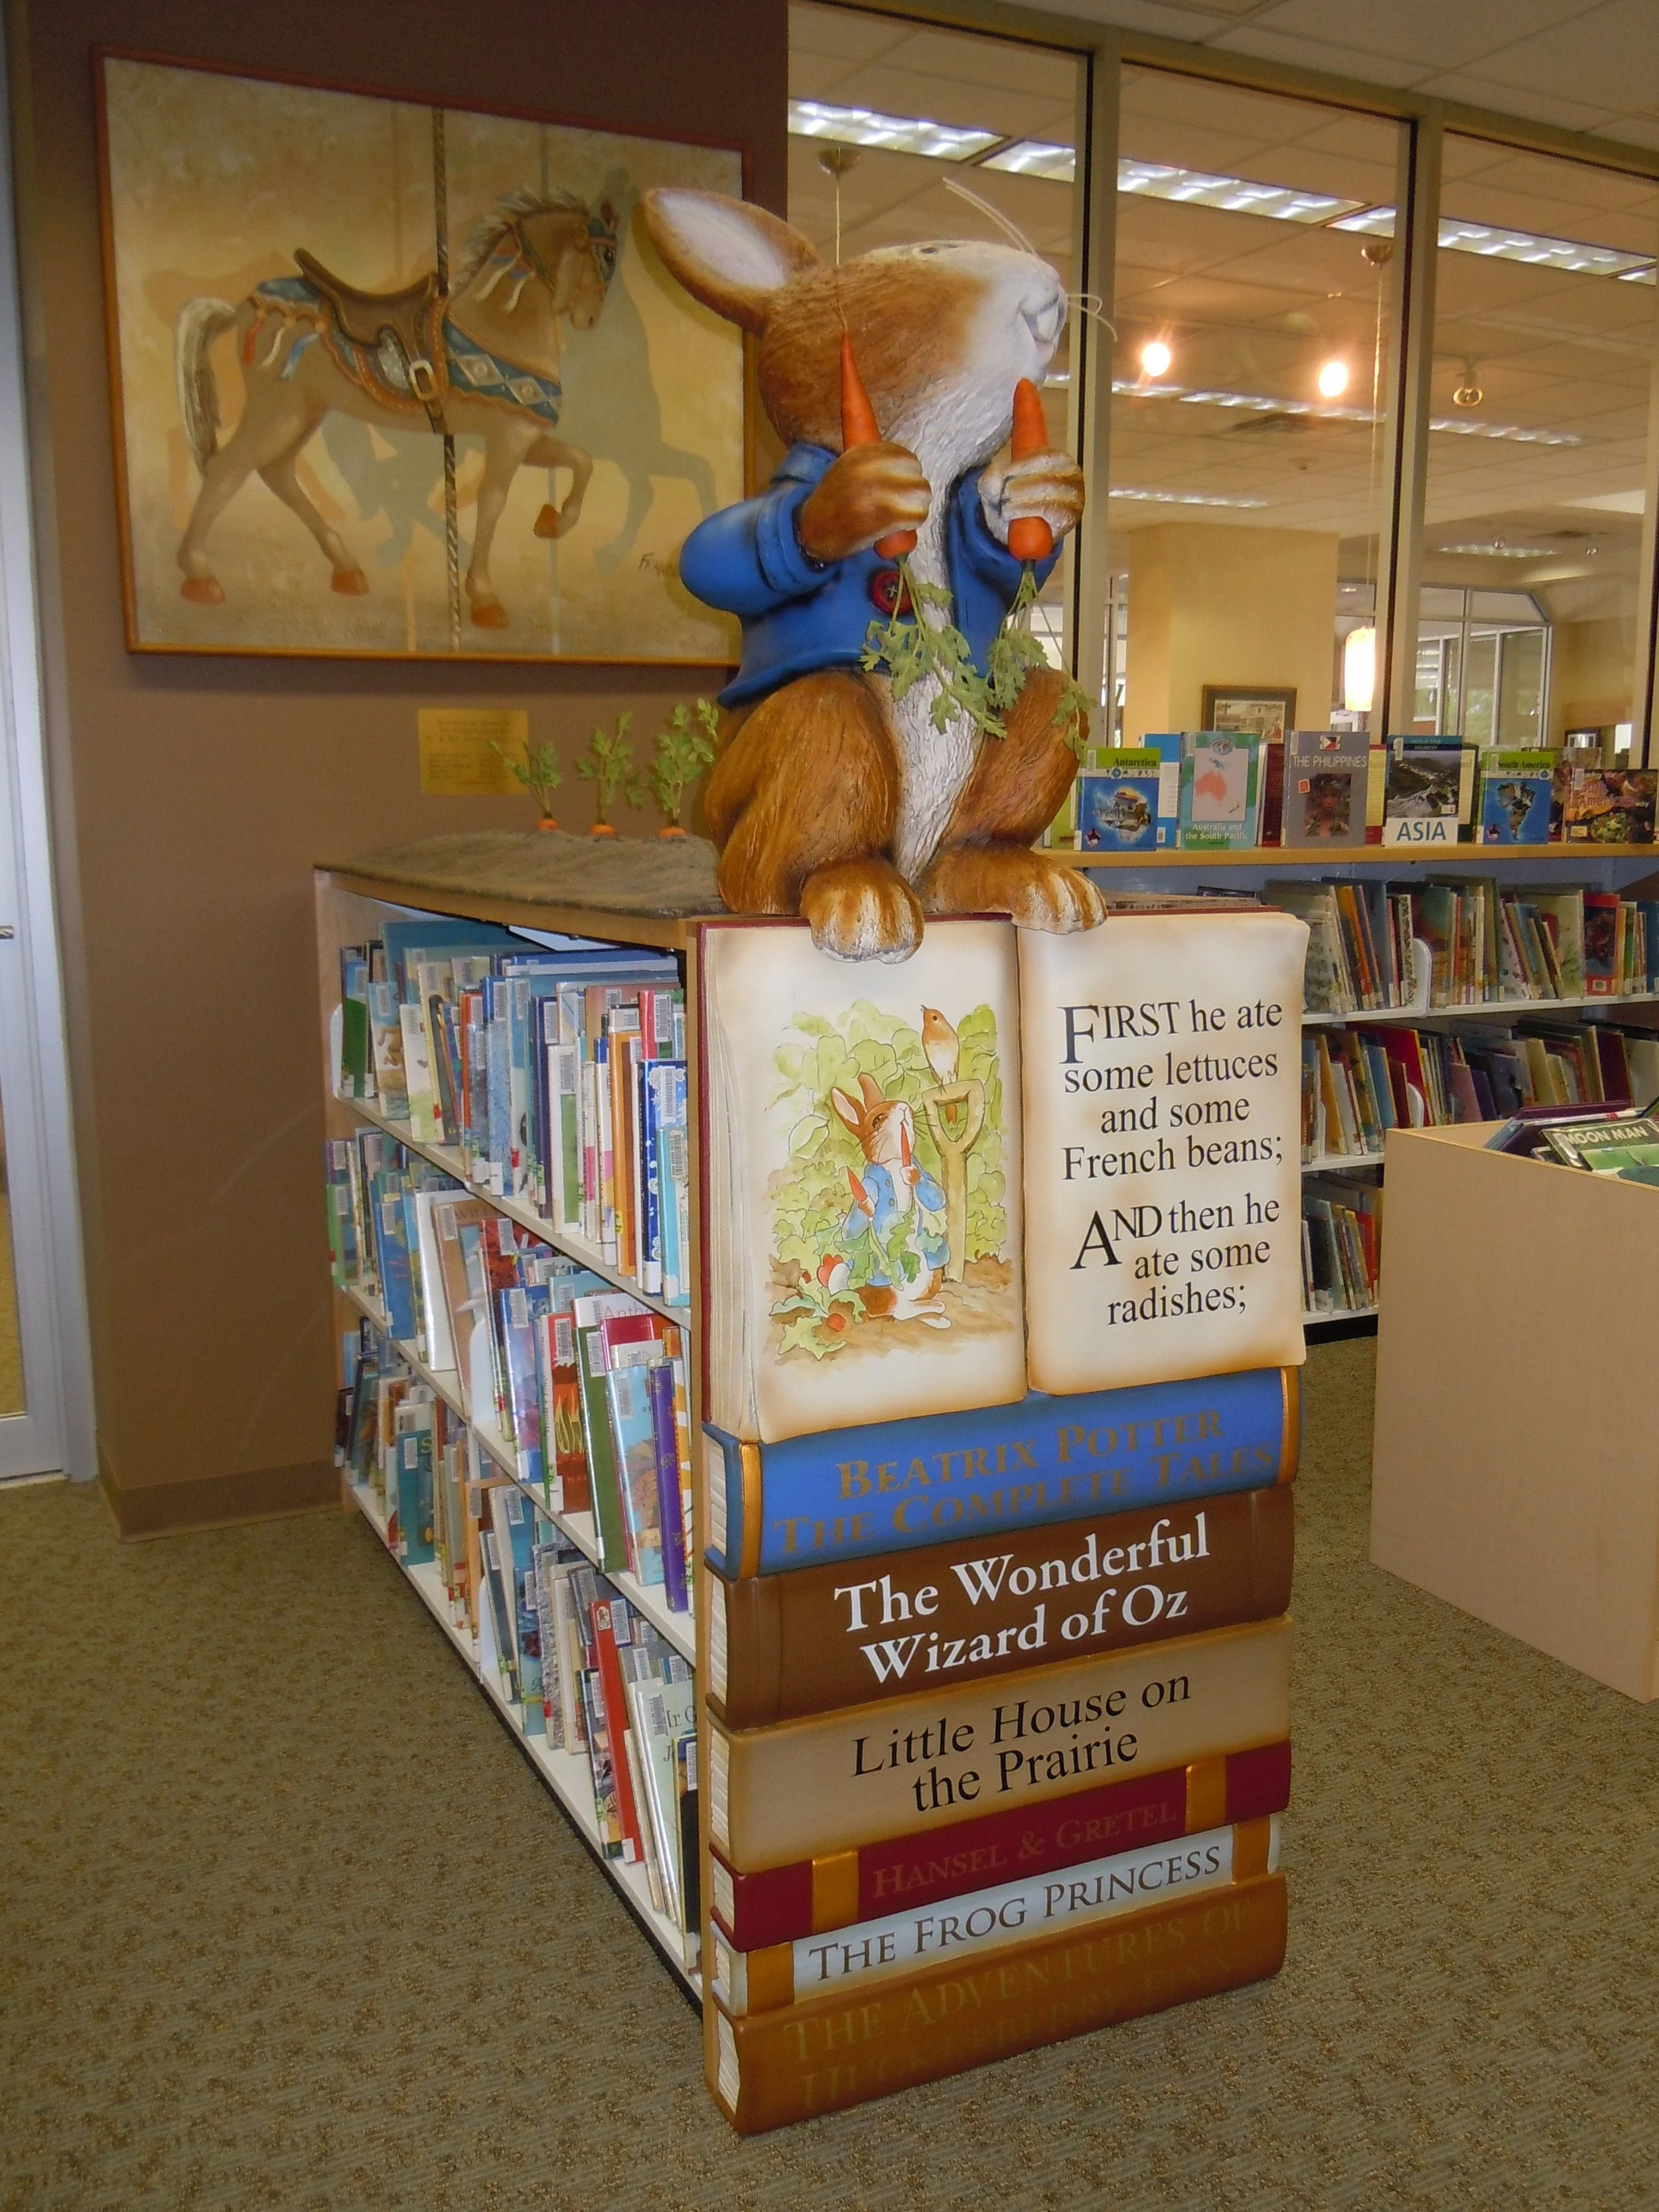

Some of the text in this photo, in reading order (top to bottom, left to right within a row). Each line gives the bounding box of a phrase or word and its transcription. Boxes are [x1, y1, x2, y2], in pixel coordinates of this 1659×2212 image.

[1114, 757, 1157, 767] Antarctica
[1293, 755, 1367, 769] THE PHILIPPINES
[1396, 821, 1447, 842] ASIA
[1057, 999, 1283, 1065] FIRST he ate
[1064, 1052, 1278, 1094] some lettuces
[1100, 1096, 1250, 1134] and some
[1562, 1126, 1649, 1145] MOON MAN
[1061, 1135, 1283, 1180] French beans;
[1069, 1192, 1280, 1270] AND then he
[1134, 1240, 1271, 1280] ate some
[1107, 1282, 1246, 1325] radishes;
[835, 1409, 1224, 1500] BEATRIX POTTER
[773, 1443, 1277, 1555] THE COMPLETE TALES
[834, 1511, 1210, 1633] The Wonderful
[859, 1584, 1189, 1684] Wizard of Oz
[850, 1674, 1192, 1778] Little House on
[911, 1726, 1139, 1812] the Prairie
[873, 1801, 1177, 1899] HANSEL & GRETEL
[808, 1845, 1221, 1981] THE FROG PRINCESS
[782, 2002, 886, 2062] THE
[899, 1917, 1188, 2033] ADVENTURES
